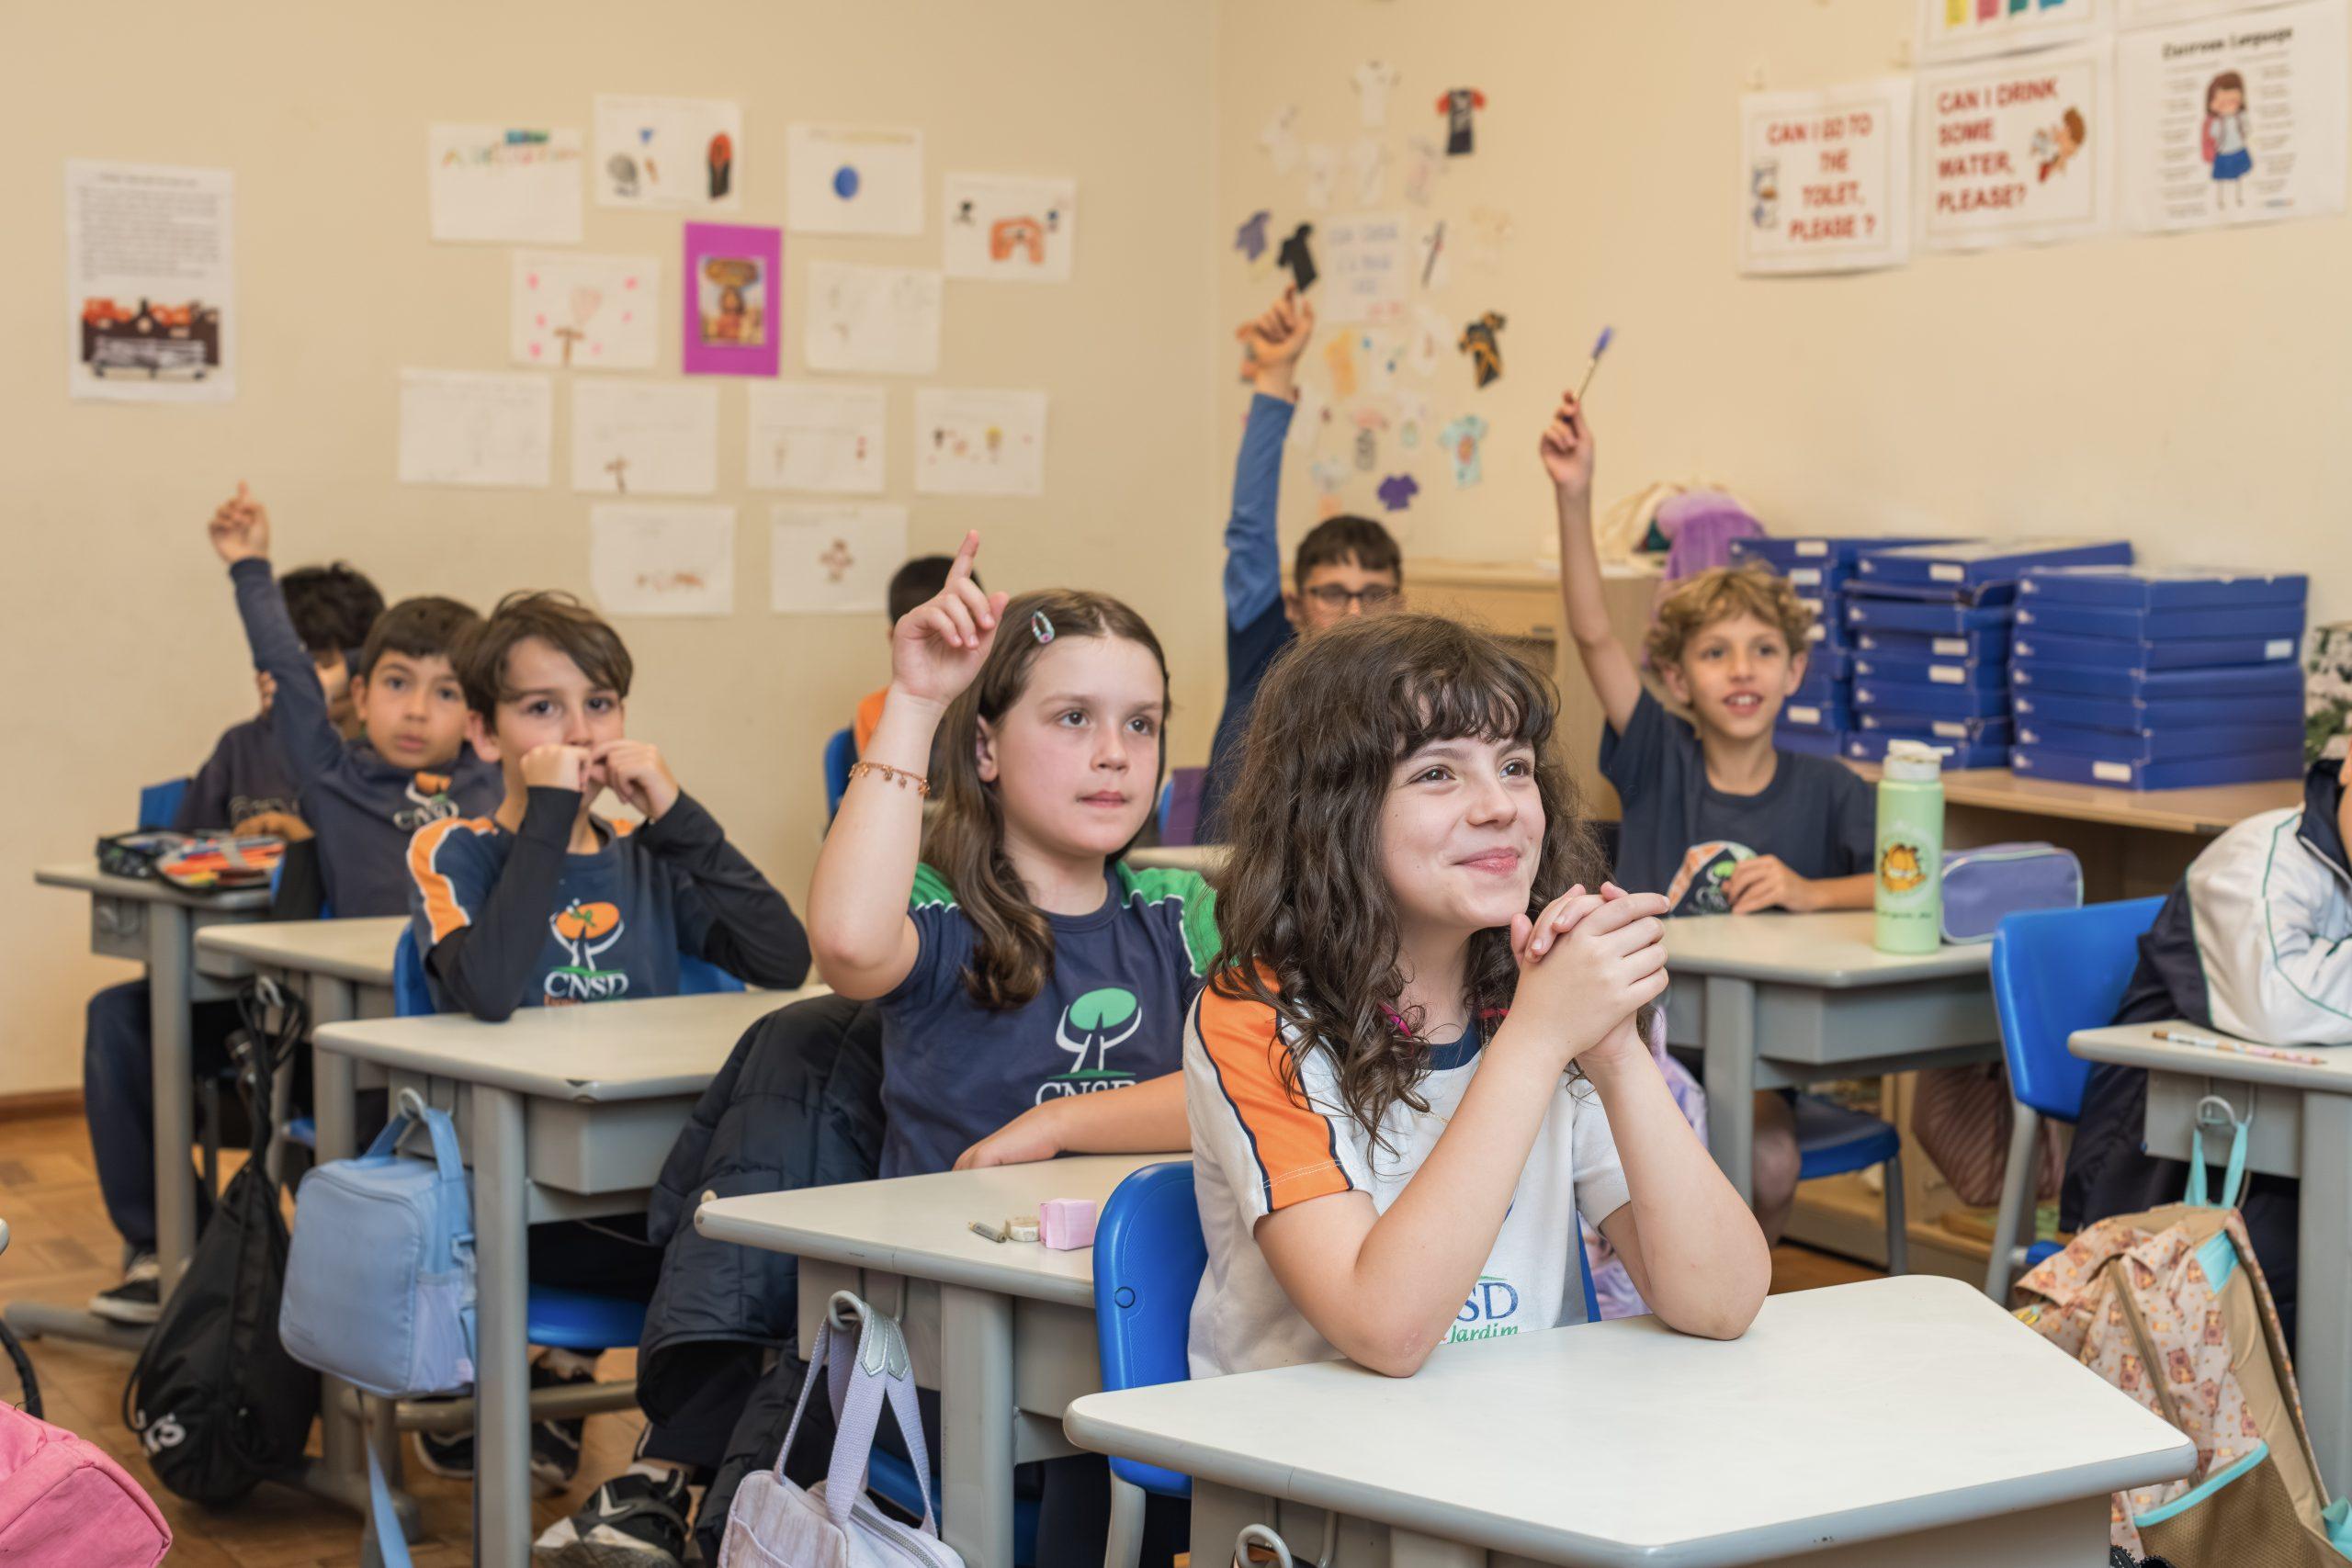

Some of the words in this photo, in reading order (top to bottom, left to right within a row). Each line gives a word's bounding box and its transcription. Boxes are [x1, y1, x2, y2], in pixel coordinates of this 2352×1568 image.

[1938, 90, 1980, 115] CAN
[1996, 76, 2058, 107] DRINK
[1767, 122, 1807, 146] CAN
[1823, 118, 1844, 141] GO
[1849, 112, 1873, 137] TO
[1939, 118, 1994, 148] SOME
[1821, 148, 1849, 173] THE
[1937, 183, 2027, 214] PLEASE?
[1789, 215, 1855, 242] PLEASE
[544, 970, 629, 999] CNSD
[1456, 1281, 1519, 1323] SD
[1447, 1323, 1519, 1345] Jardim
